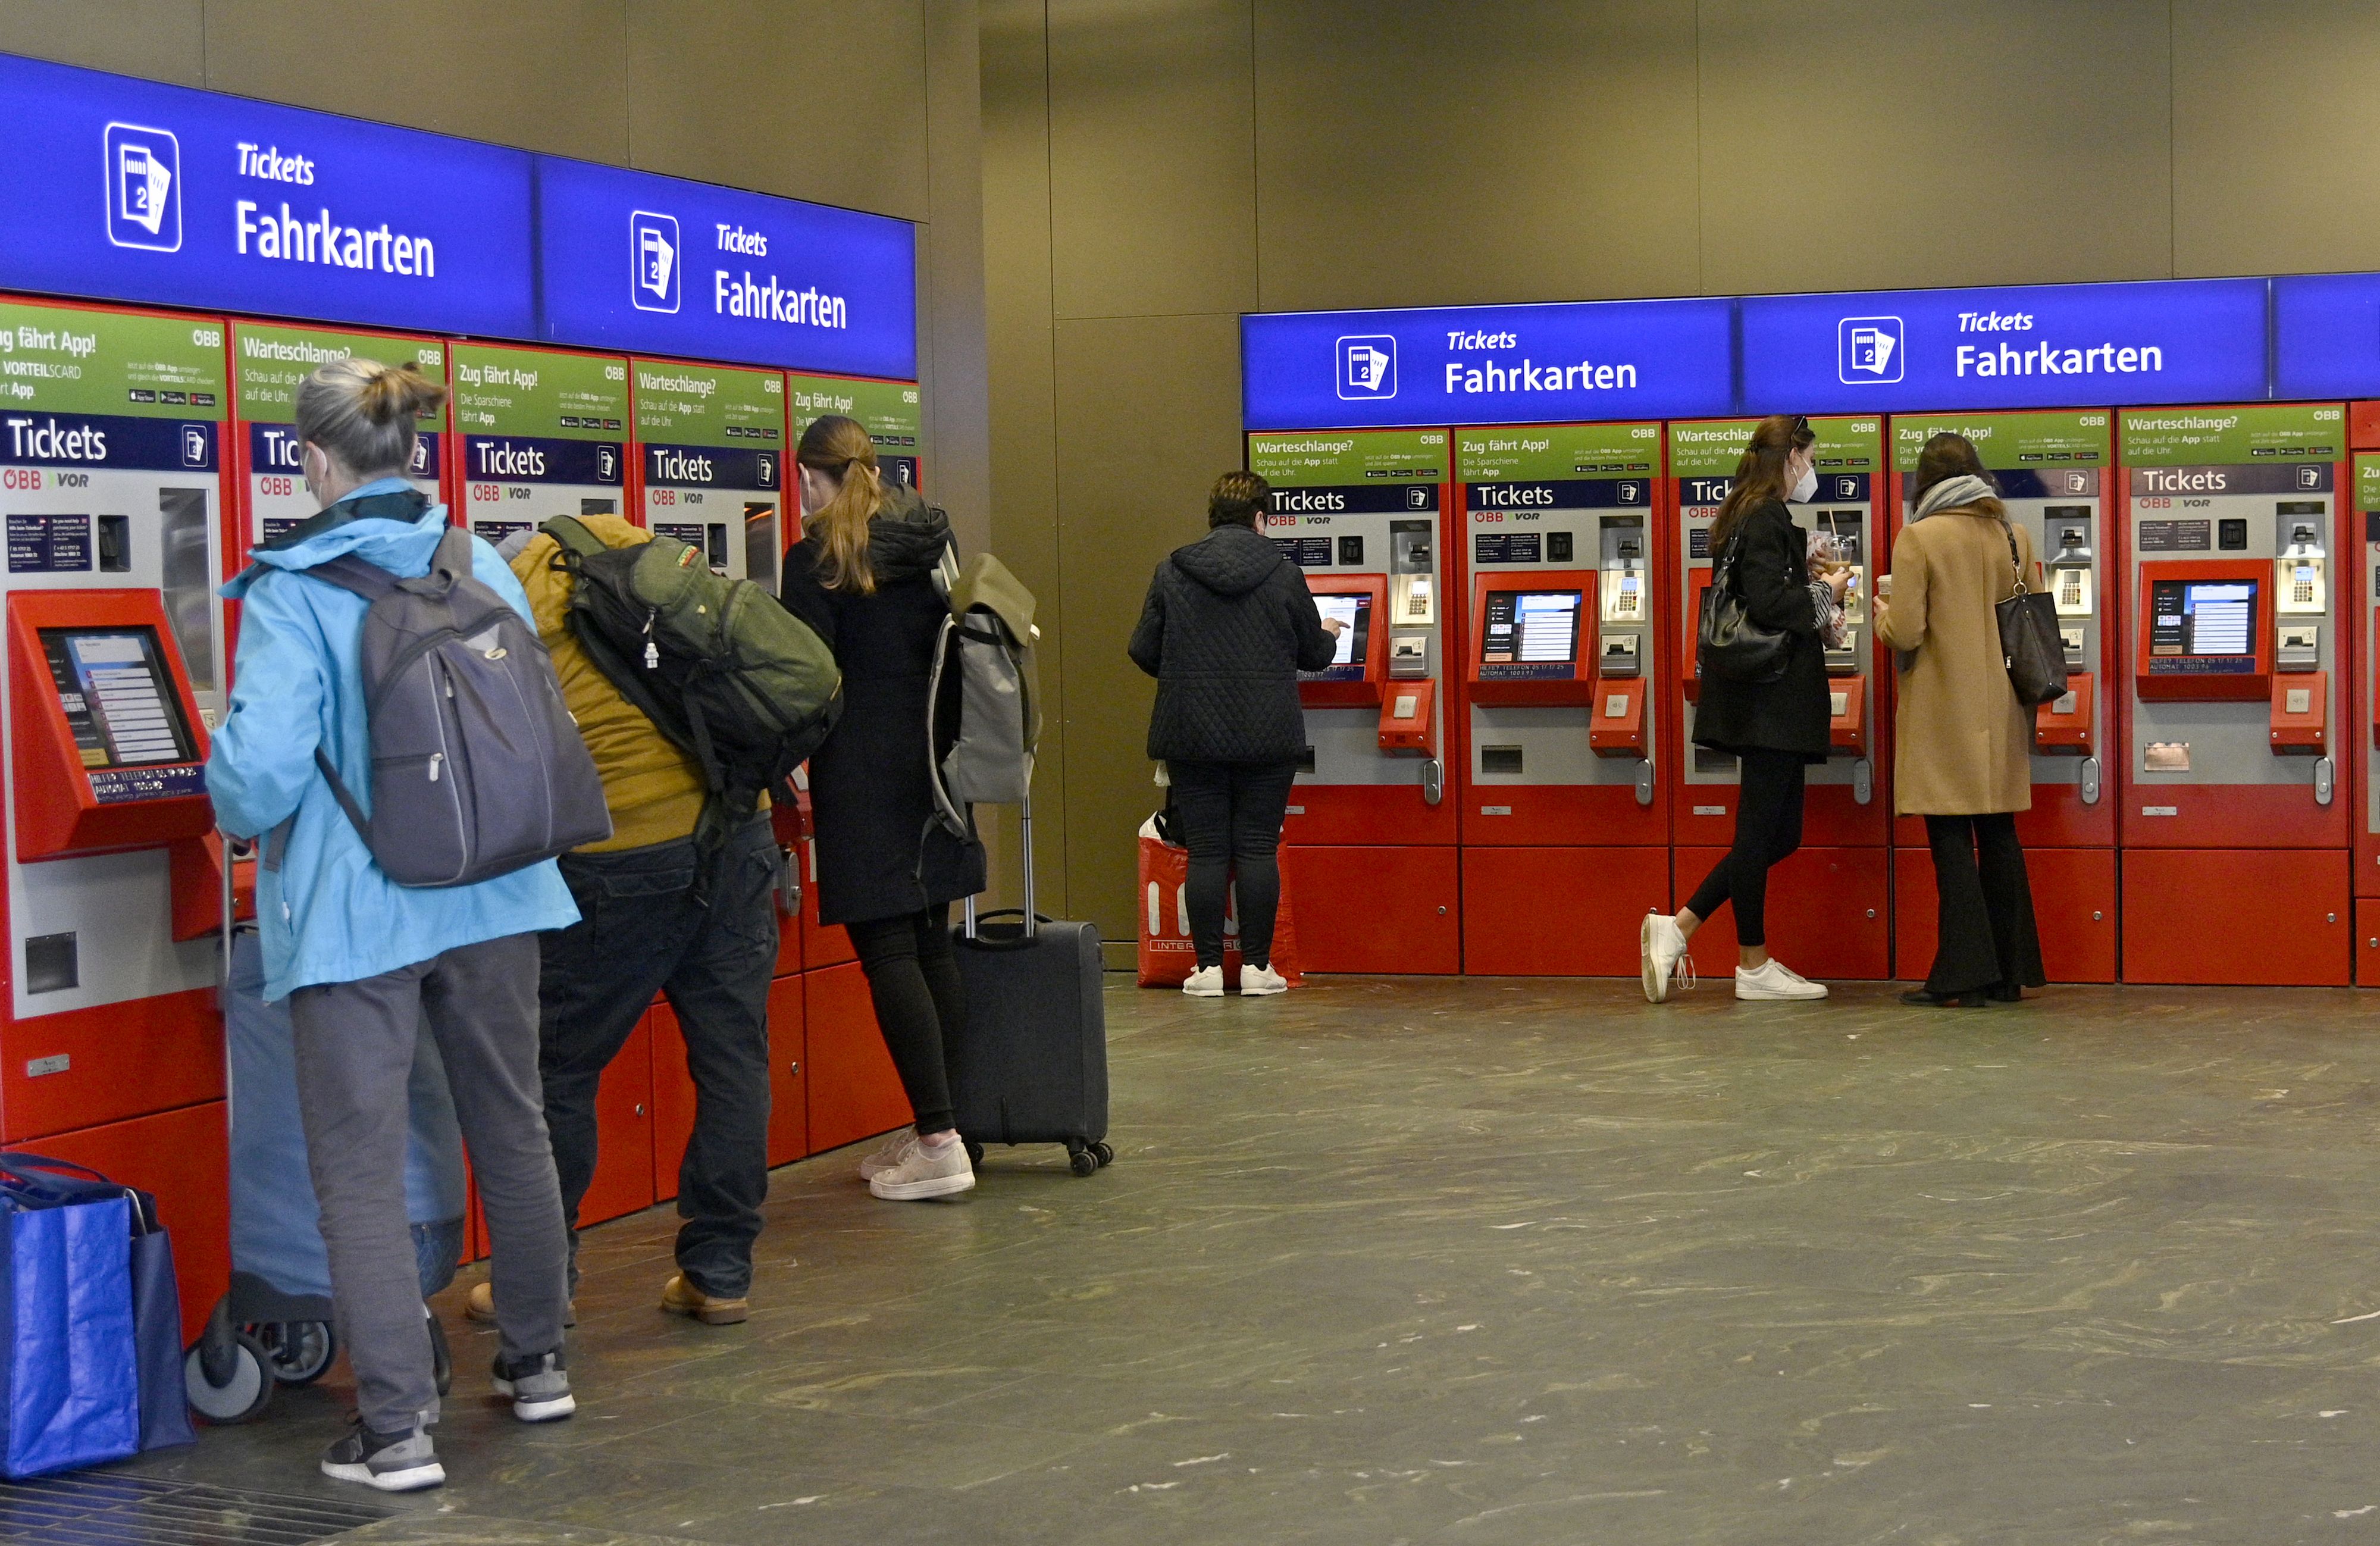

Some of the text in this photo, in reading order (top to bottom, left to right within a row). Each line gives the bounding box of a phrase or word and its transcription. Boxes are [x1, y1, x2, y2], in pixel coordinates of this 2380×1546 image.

[237, 142, 315, 186] Tickets
[237, 201, 435, 278] Fahrkarten
[716, 224, 767, 256] Tickets
[716, 270, 846, 329] Fahrkarten
[1958, 311, 2033, 333] Tickets
[18, 326, 57, 350] fährt
[61, 331, 96, 358] App!
[193, 329, 221, 347] ÖBB
[1447, 329, 1517, 350] Tickets
[418, 349, 441, 366] ÖBB
[1956, 340, 2162, 377] Fahrkarten
[4, 361, 82, 379] VORTEILSCARD
[245, 368, 268, 383] Schau
[270, 370, 283, 383] auf
[284, 371, 296, 385] die
[459, 364, 538, 390] Zug fährt App!
[605, 365, 625, 381] ÖBB
[1446, 359, 1636, 394] Fahrkarten
[639, 372, 716, 399] Warteschlange?
[764, 378, 781, 393] ÖBB
[245, 389, 290, 403] auf die Uhr.
[461, 393, 512, 409] Die Sparschiene
[795, 392, 853, 414] Zug fährt App!
[640, 398, 706, 415] Schau auf die App statt
[461, 411, 478, 423] fährt
[641, 415, 650, 426] auf
[651, 415, 660, 427] die
[796, 416, 804, 427] Die
[2080, 417, 2105, 427] ÖBB
[2313, 410, 2340, 420] ÖBB
[1851, 423, 1876, 433] ÖBB
[2128, 416, 2238, 431] Warteschlange?
[8, 418, 107, 461] Tickets
[1420, 435, 1443, 445] ÖBB
[1631, 428, 1656, 439] ÖBB
[1899, 428, 1923, 442] Zug
[1962, 427, 1992, 440] App!
[2128, 434, 2220, 446] Schau auf die App statt
[1256, 440, 1354, 455] Warteschlange?
[1463, 439, 1549, 455] Zug fährt App!
[1700, 447, 1712, 455] auf
[1714, 447, 1726, 455] die
[1727, 446, 1745, 456] App
[1900, 446, 1912, 455] Die
[2128, 446, 2172, 456] auf die Uhr.
[476, 441, 546, 476] Tickets
[653, 449, 714, 482] Tickets
[1256, 458, 1277, 467] Schau
[1279, 458, 1290, 467] auf
[1292, 458, 1302, 467] die
[1304, 458, 1321, 468] App
[1463, 457, 1519, 467] Die Sparschiene
[1690, 458, 1702, 466] die
[1703, 458, 1719, 466] Uhr.
[1900, 457, 1918, 465] fährt
[4, 469, 42, 490] ÖBB
[1270, 468, 1280, 477] die
[1282, 468, 1296, 477] Uhr.
[1463, 468, 1480, 476] fährt
[57, 473, 89, 488] VOR
[261, 477, 292, 496] ÖBB
[2143, 470, 2226, 491] Tickets
[473, 484, 500, 502] ÖBB
[509, 487, 531, 500] VOR
[1477, 484, 1554, 506] Tickets
[1691, 480, 1734, 502] Tick
[2363, 485, 2377, 493] Die
[652, 489, 675, 506] ÖBB
[684, 492, 703, 505] VOR
[1271, 490, 1345, 511] Tickets
[2140, 497, 2171, 509] ÖBB
[2183, 499, 2210, 508] VOR
[2363, 496, 2380, 505] fähr
[1475, 512, 1504, 522] ÖBB
[1515, 512, 1540, 521] VOR
[1689, 507, 1718, 518] ÖBB
[1269, 515, 1296, 526] ÖBB
[1307, 517, 1331, 525] VOR
